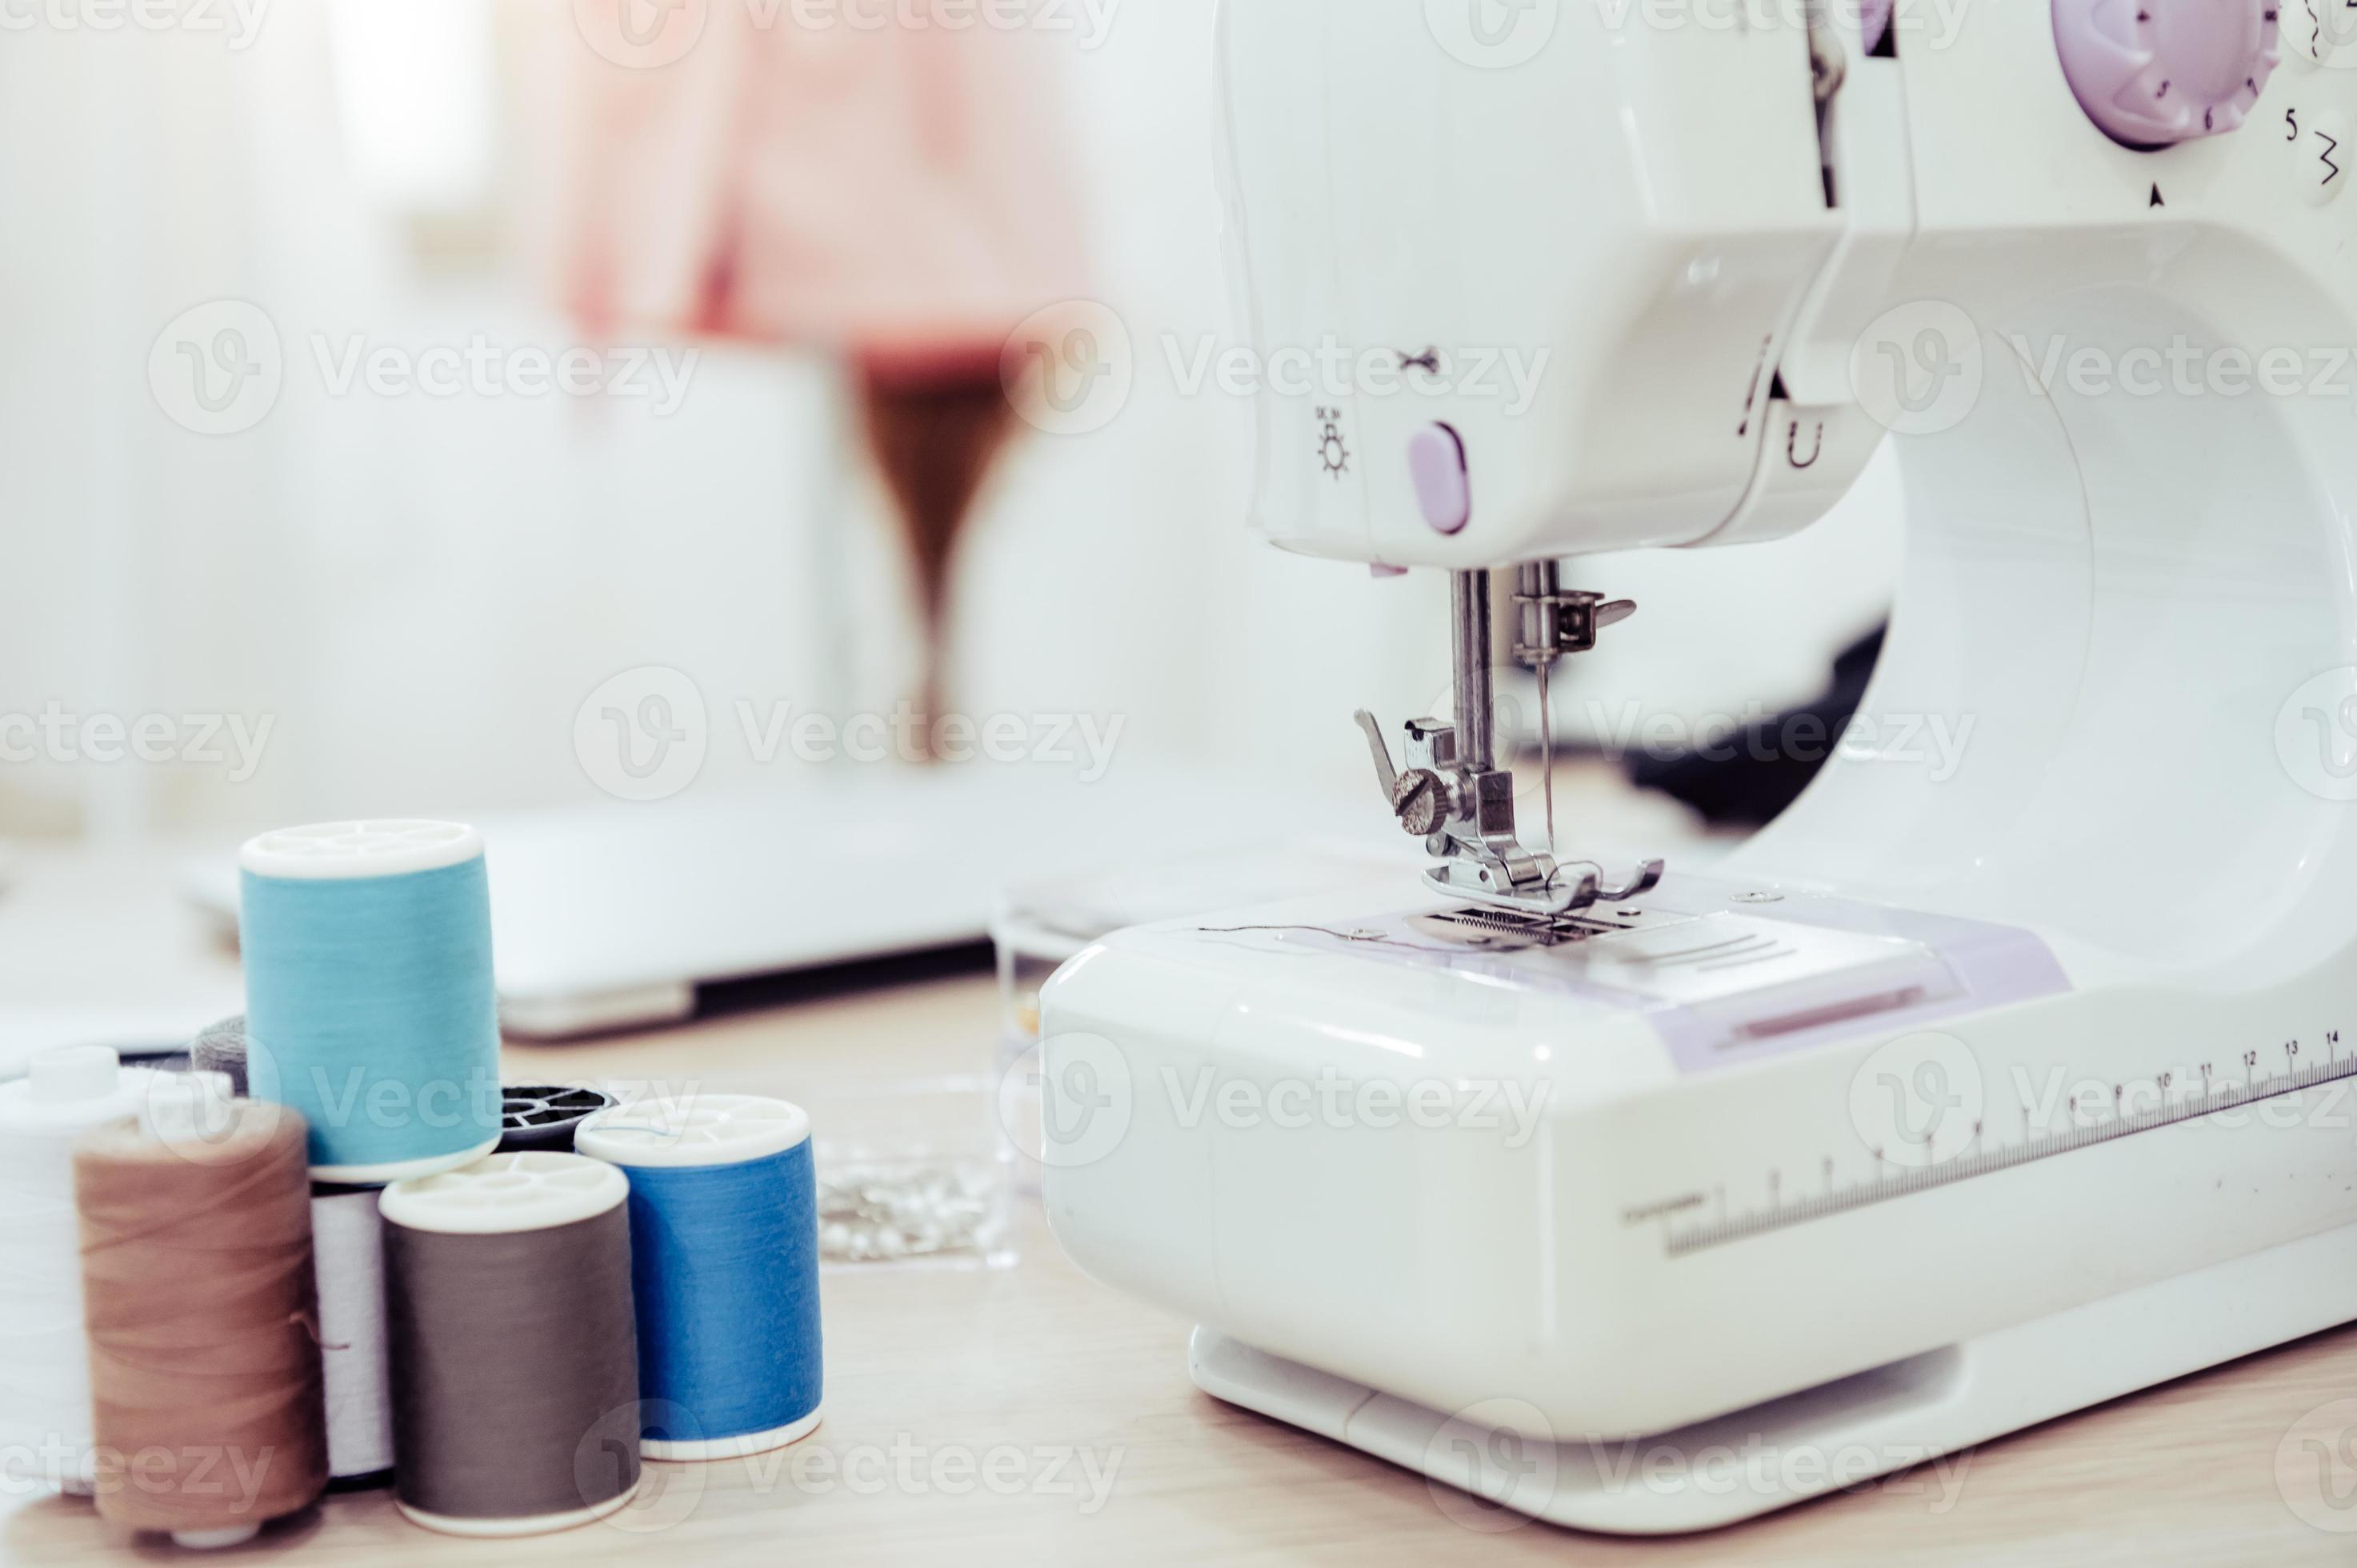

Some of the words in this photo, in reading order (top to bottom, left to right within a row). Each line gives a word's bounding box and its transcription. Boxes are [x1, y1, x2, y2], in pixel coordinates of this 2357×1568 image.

[2286, 109, 2298, 141] 5
[2158, 1073, 2171, 1089] 10
[2201, 1062, 2212, 1078] 11
[2243, 1051, 2256, 1066] 12
[2285, 1040, 2298, 1054] 13
[2327, 1030, 2339, 1045] 14
